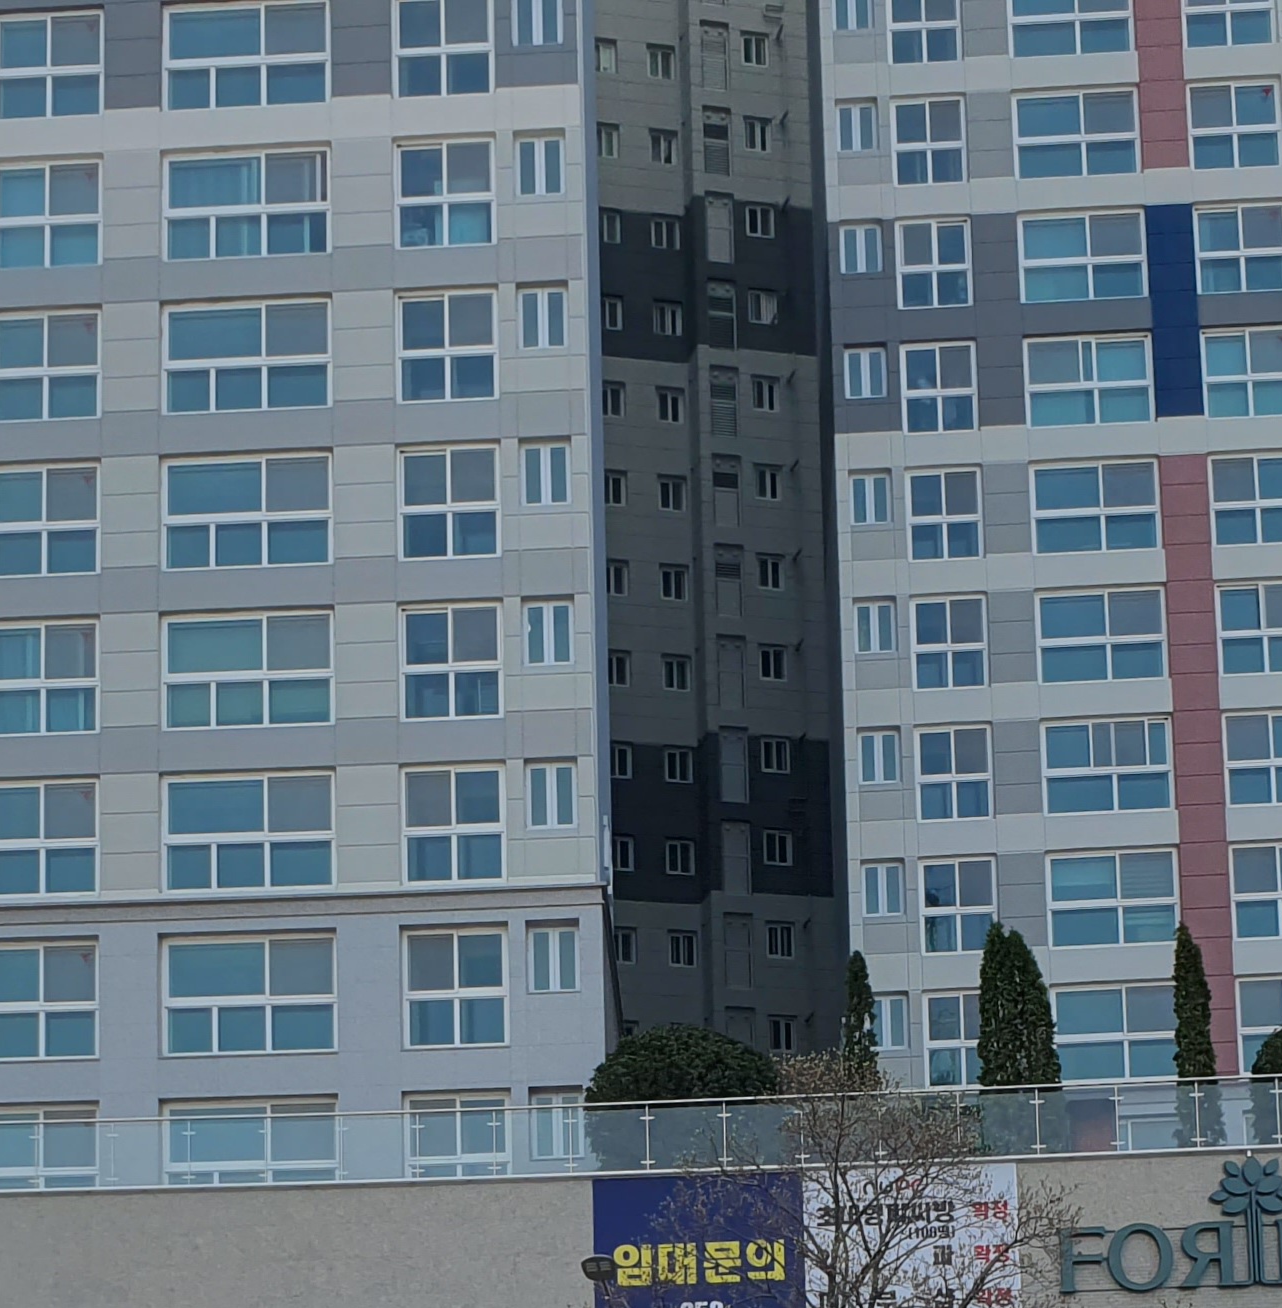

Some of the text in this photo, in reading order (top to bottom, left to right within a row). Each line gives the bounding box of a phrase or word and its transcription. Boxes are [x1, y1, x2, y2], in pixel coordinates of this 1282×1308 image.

[973, 1200, 1008, 1220] 확정
[613, 1238, 786, 1287] 임대문의
[974, 1244, 1010, 1263] 확정
